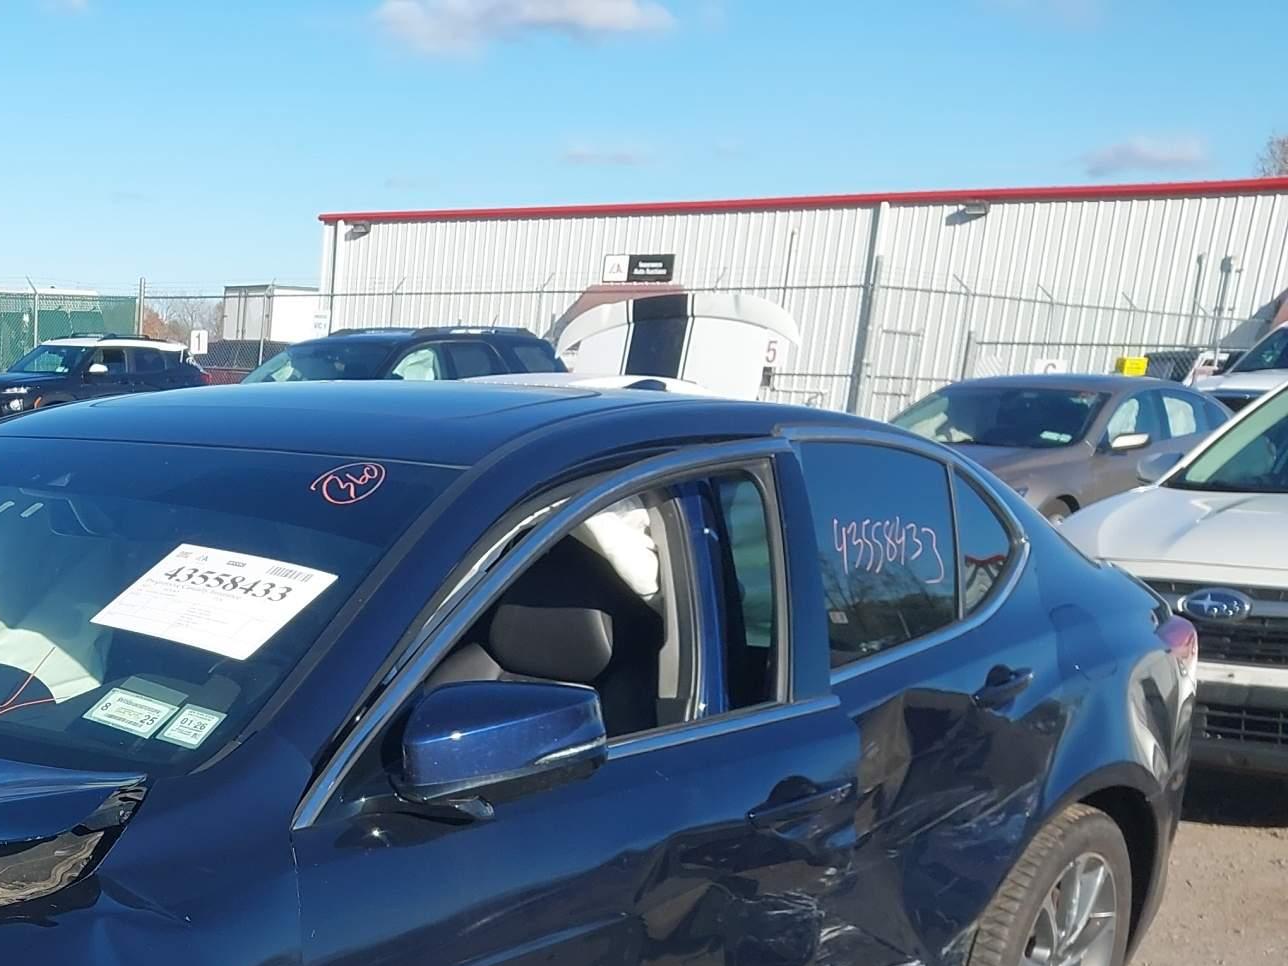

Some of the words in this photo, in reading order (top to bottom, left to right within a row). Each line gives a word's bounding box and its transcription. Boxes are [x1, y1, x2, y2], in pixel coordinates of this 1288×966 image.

[765, 340, 778, 363] 5
[832, 515, 945, 584] 43558433
[163, 565, 294, 603] 43558433
[100, 702, 112, 712] 8
[139, 714, 160, 726] 25
